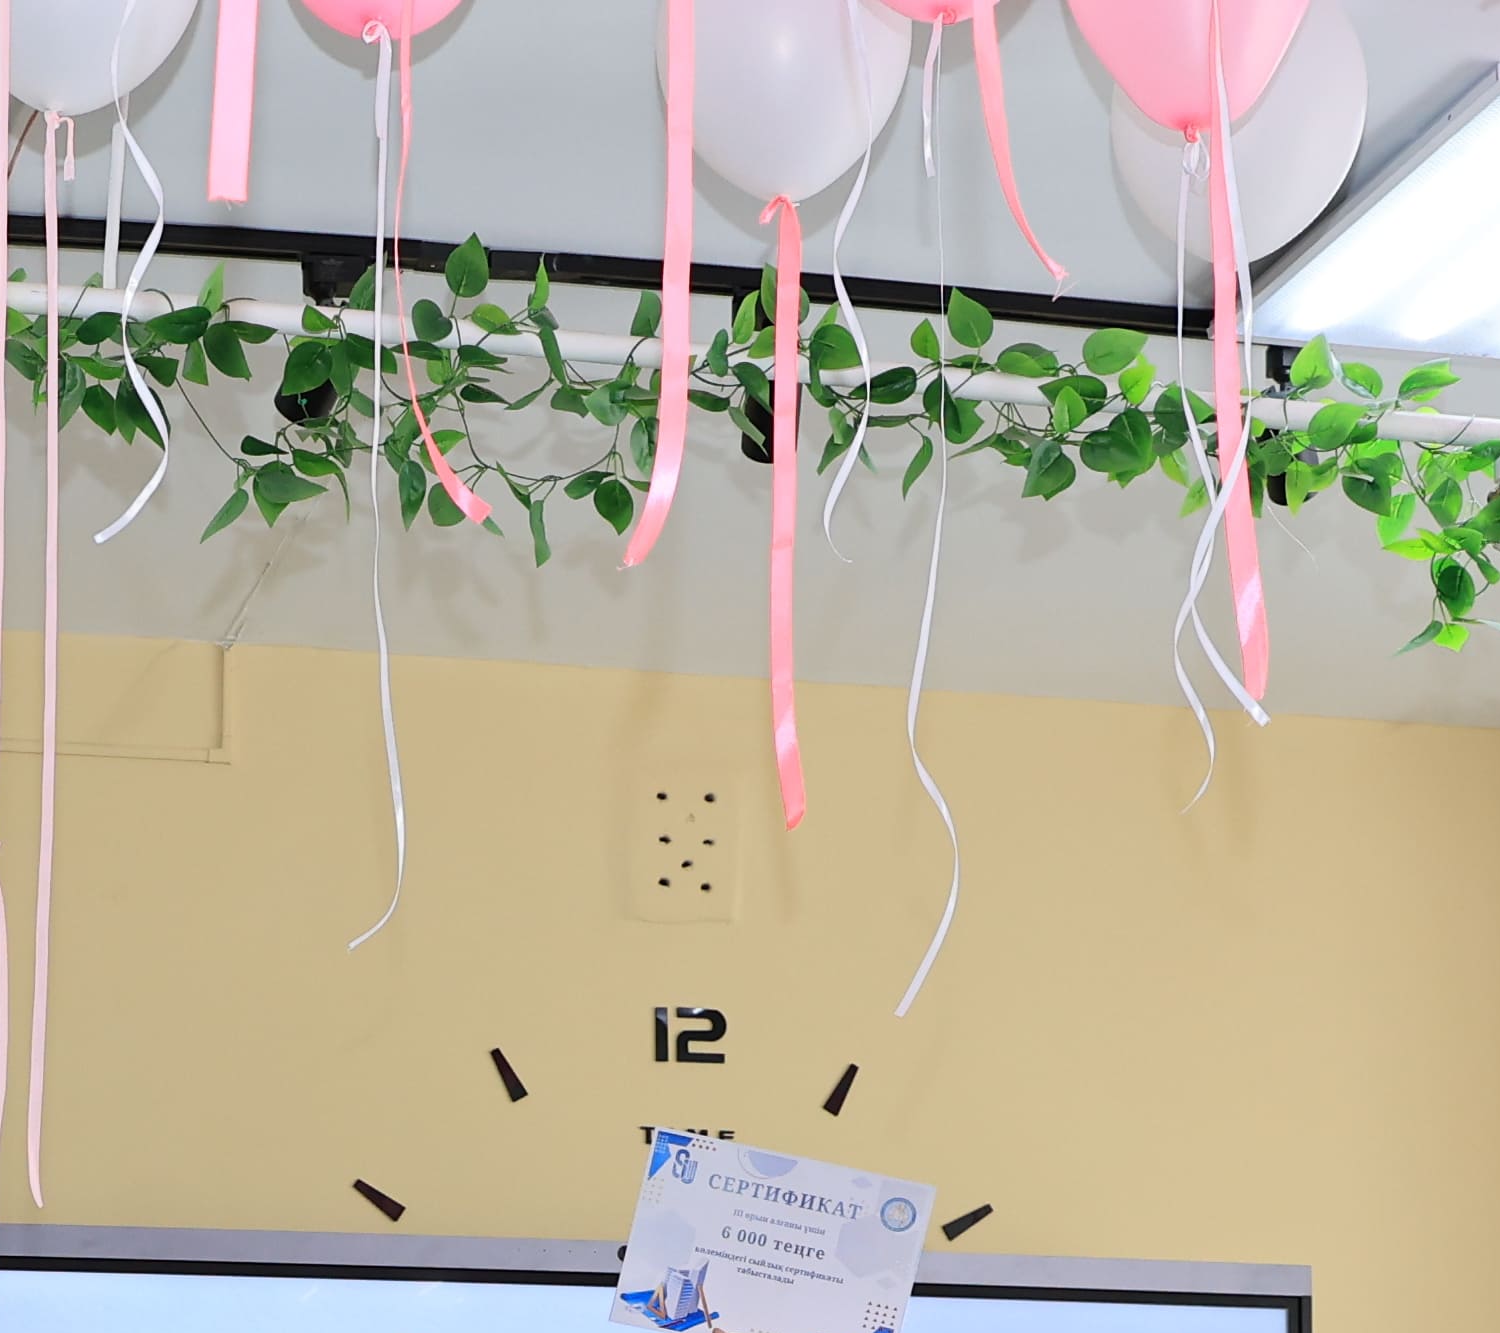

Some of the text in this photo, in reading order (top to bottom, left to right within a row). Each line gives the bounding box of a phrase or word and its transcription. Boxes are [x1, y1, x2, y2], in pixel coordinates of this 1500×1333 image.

[653, 1006, 728, 1063] 12
[707, 1173, 863, 1220] СЕРТИФИКАТ
[721, 1225, 826, 1260] 6 000 теңге
[784, 1265, 844, 1285] сертификаты
